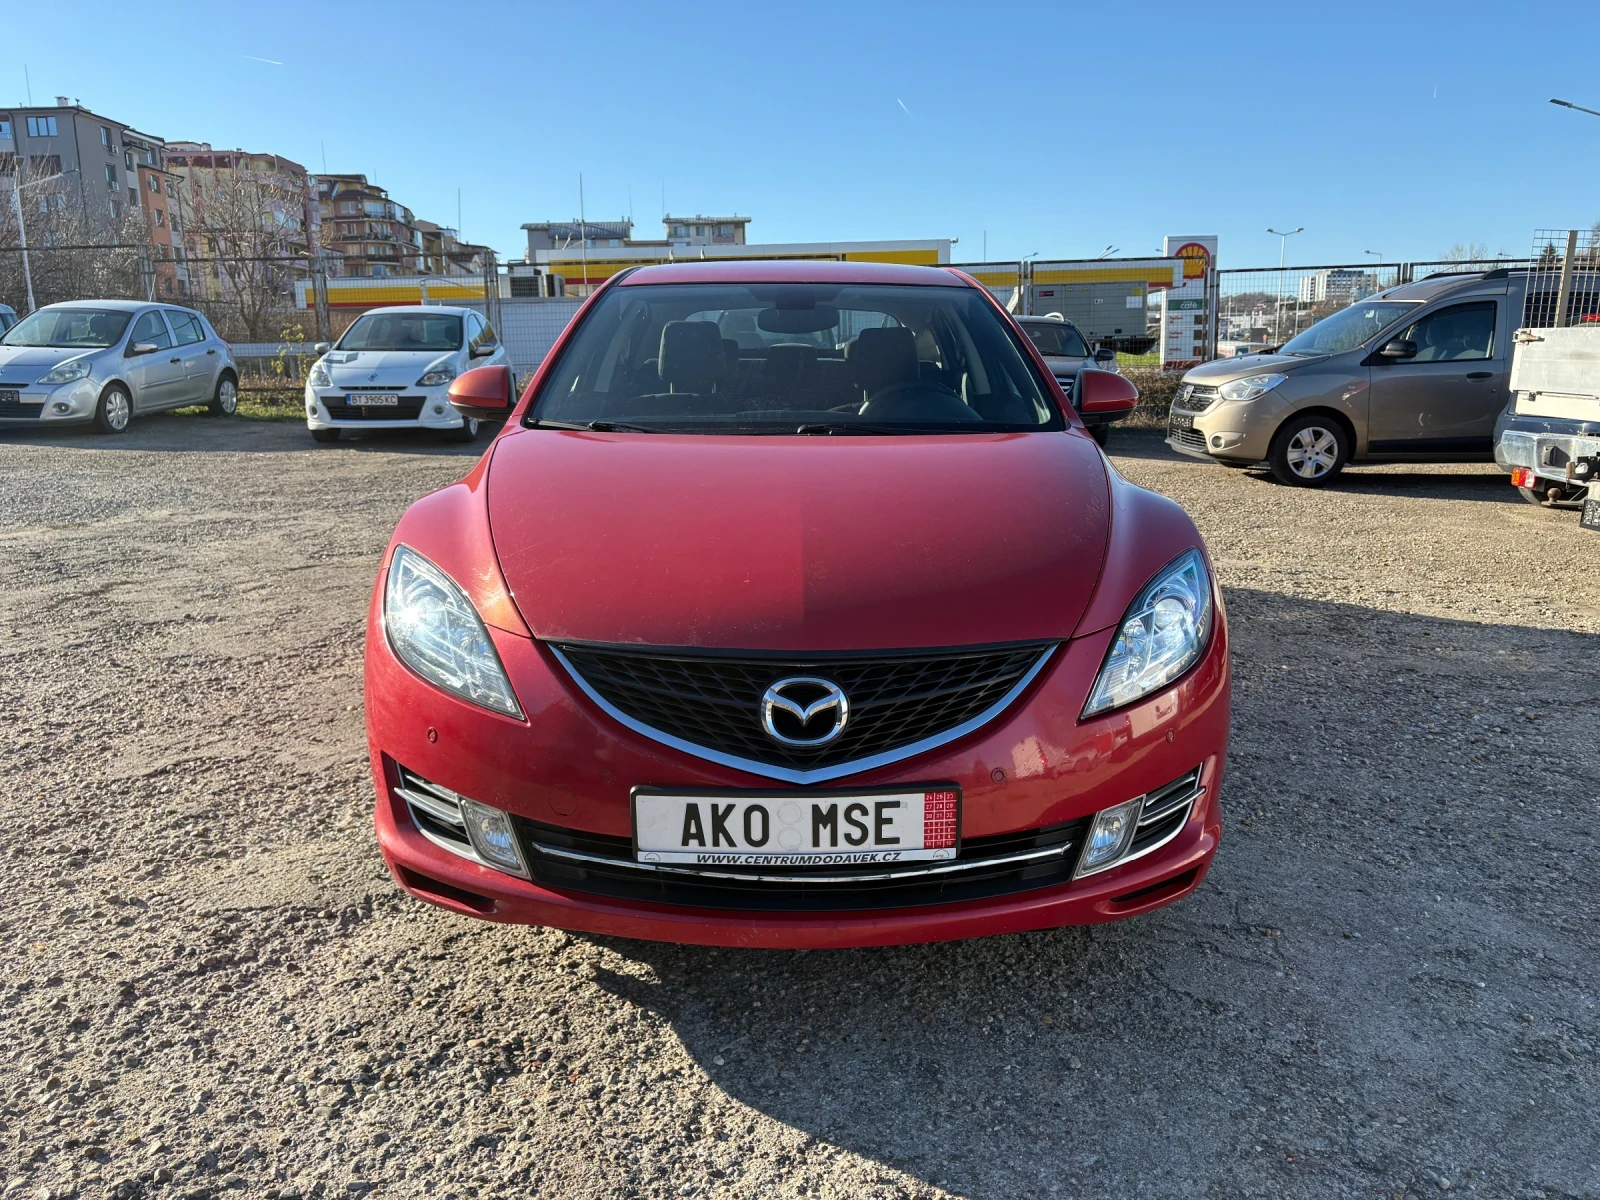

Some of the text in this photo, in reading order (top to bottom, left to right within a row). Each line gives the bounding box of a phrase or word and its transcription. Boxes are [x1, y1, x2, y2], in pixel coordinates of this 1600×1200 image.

[352, 395, 396, 404] BT 3905 KC
[681, 801, 901, 847] AKO MSE
[696, 852, 902, 865] WWW.CENTRUMDODAVEK.CZ
